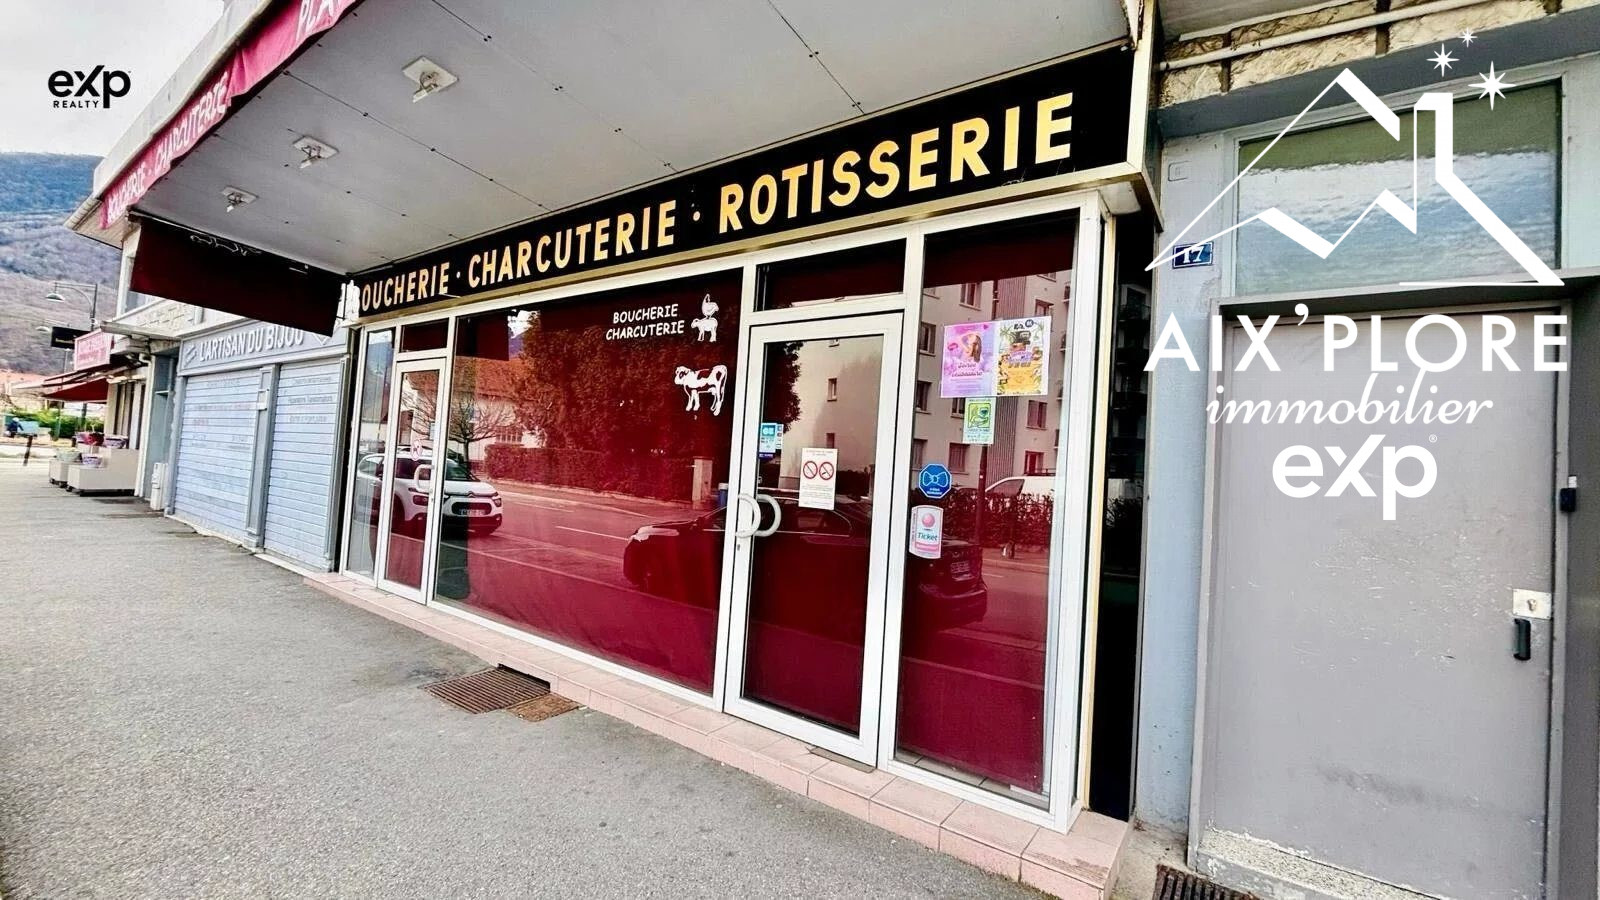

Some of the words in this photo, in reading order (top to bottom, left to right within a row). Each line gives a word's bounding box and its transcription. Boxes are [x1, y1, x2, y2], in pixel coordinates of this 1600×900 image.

[360, 262, 450, 312] OUCHERIE
[467, 199, 677, 289] CHARCUTERIE
[718, 92, 1074, 235] ROTISSERIE
[1183, 245, 1205, 263] 17
[613, 303, 679, 324] BOUCHERIE
[605, 320, 685, 341] CHARCUTERIE
[199, 331, 247, 362] L'ARTISAN
[247, 327, 264, 354] DU
[265, 325, 304, 351] BIJOU
[917, 532, 938, 541] Ticket
